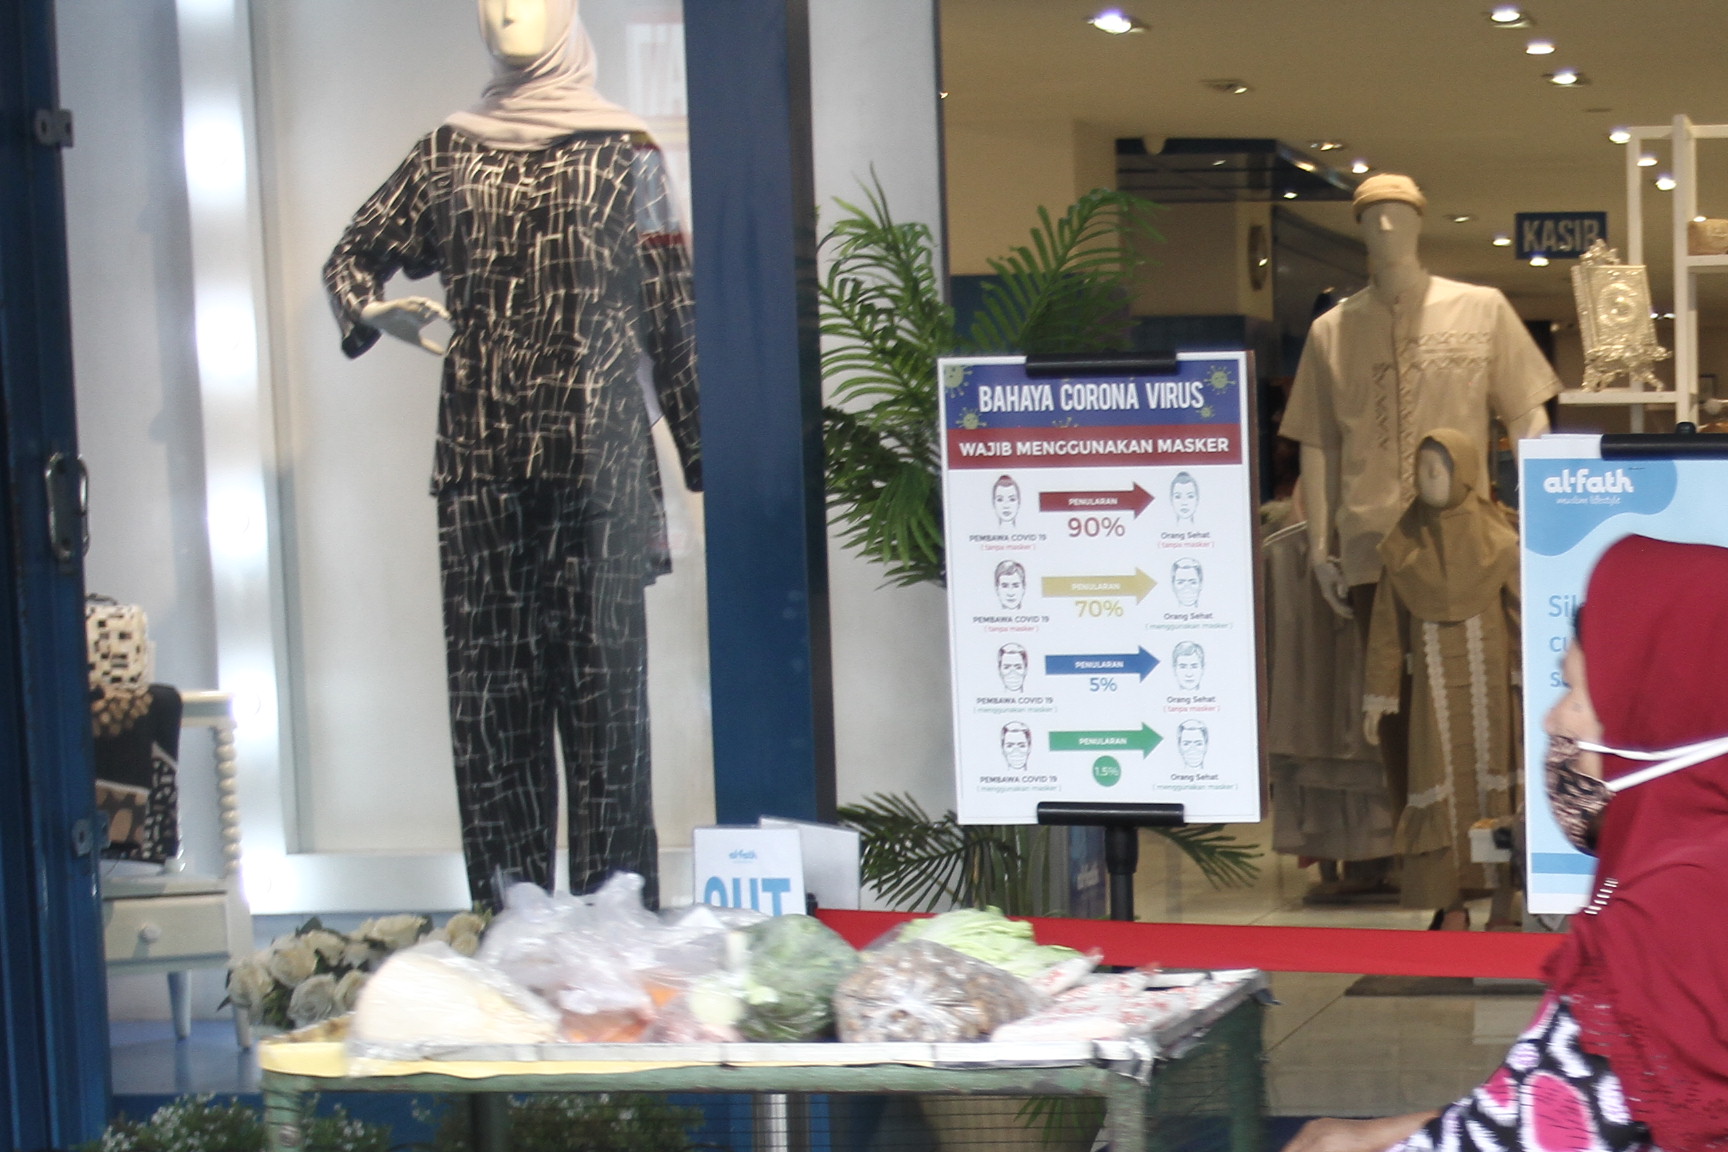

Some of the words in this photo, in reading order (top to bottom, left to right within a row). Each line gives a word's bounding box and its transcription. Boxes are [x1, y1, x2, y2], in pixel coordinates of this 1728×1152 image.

[978, 384, 1055, 412] BAHAYA
[1060, 383, 1140, 411] CORONA
[1145, 381, 1204, 410] VIRUS
[959, 441, 1013, 457] WAJIB
[1016, 439, 1154, 456] MENGGUNAKAN
[1157, 437, 1230, 453] MASKER
[1068, 497, 1119, 506] PENULARAN
[1067, 517, 1126, 538] 90%
[969, 534, 1009, 542] PEMBAWA
[1161, 532, 1185, 540] Orang
[1187, 531, 1210, 539] Sehat
[1071, 582, 1121, 591] PENULARAN
[1075, 600, 1124, 618] 70%
[1014, 615, 1041, 623] COVID
[1041, 615, 1050, 623] 19
[1163, 612, 1188, 621] Orang
[1190, 612, 1213, 620] Sehat
[1074, 660, 1125, 669] PENULARAN
[1089, 677, 1118, 692] 5%
[976, 697, 1016, 705] PEMBAWA
[1045, 696, 1054, 704] 19
[1166, 696, 1191, 704] Orang
[1079, 737, 1128, 746] PENULARAN
[1048, 775, 1058, 783] 19
[1170, 773, 1195, 782] Orang
